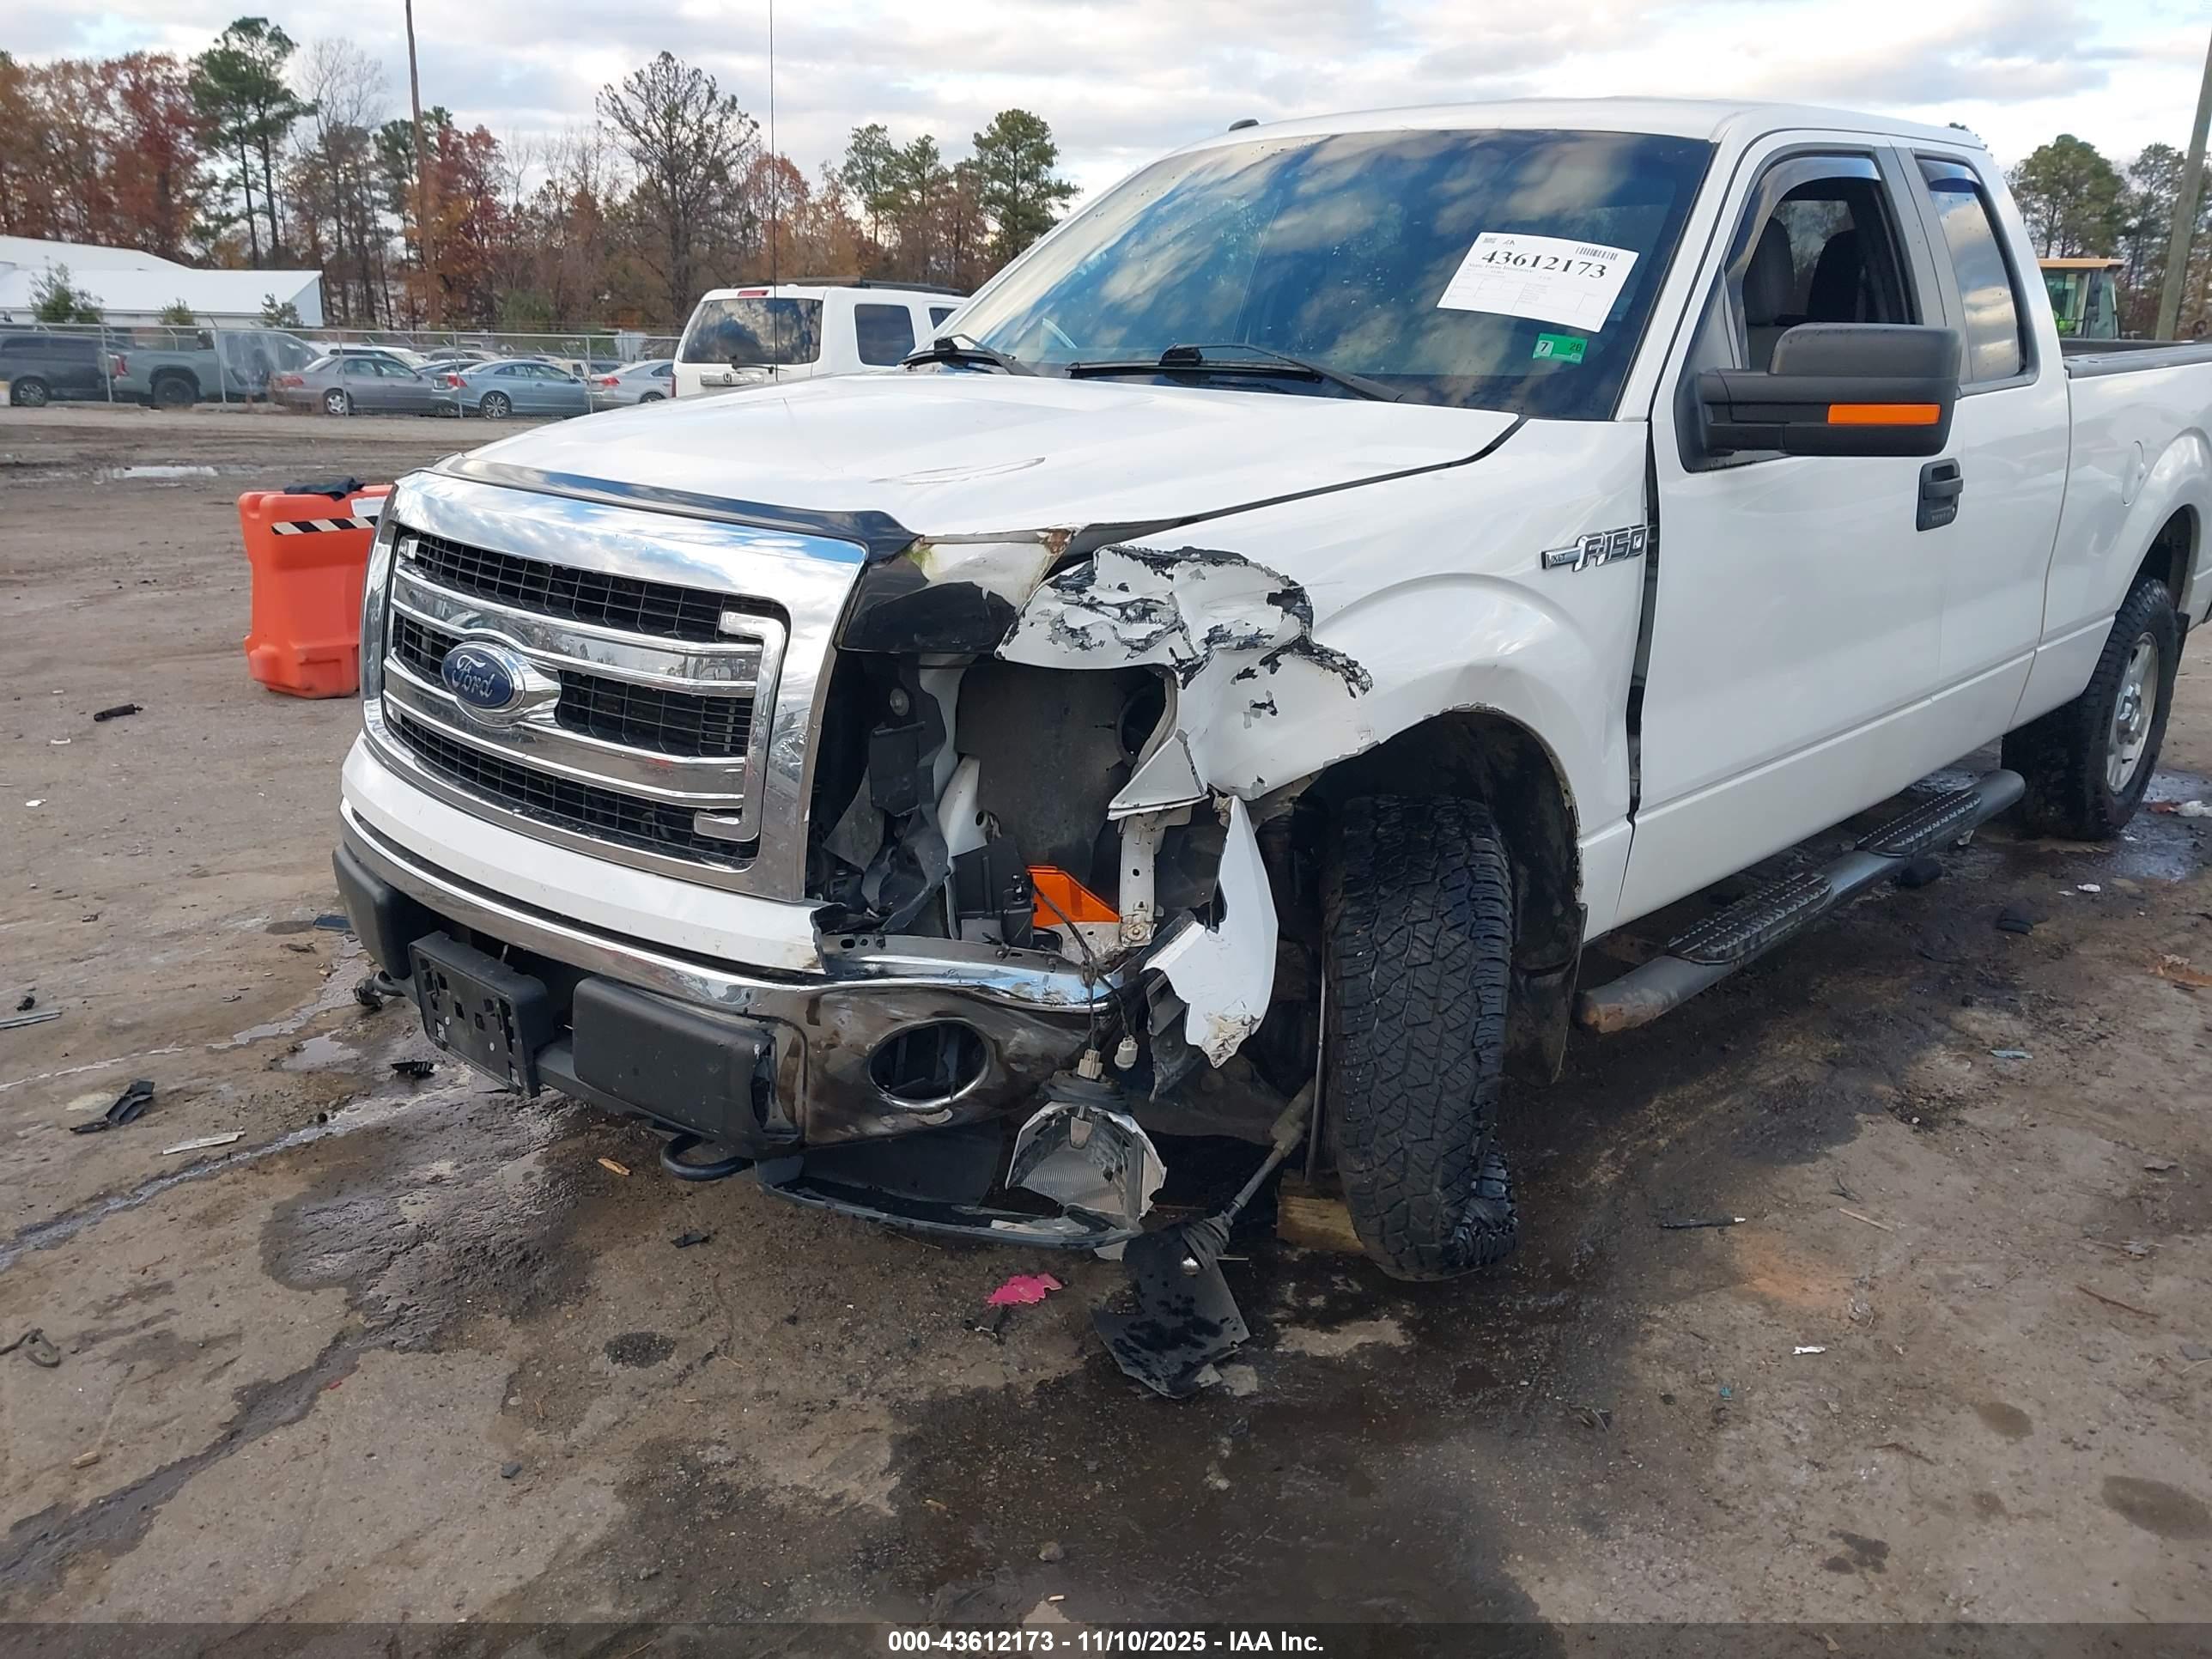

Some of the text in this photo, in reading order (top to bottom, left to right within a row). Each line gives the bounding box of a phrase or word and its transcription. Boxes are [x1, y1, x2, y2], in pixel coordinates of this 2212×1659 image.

[1481, 250, 1607, 279] 43612173
[1540, 342, 1549, 352] 7
[1551, 553, 1566, 563] XLT
[452, 654, 495, 698] Ford
